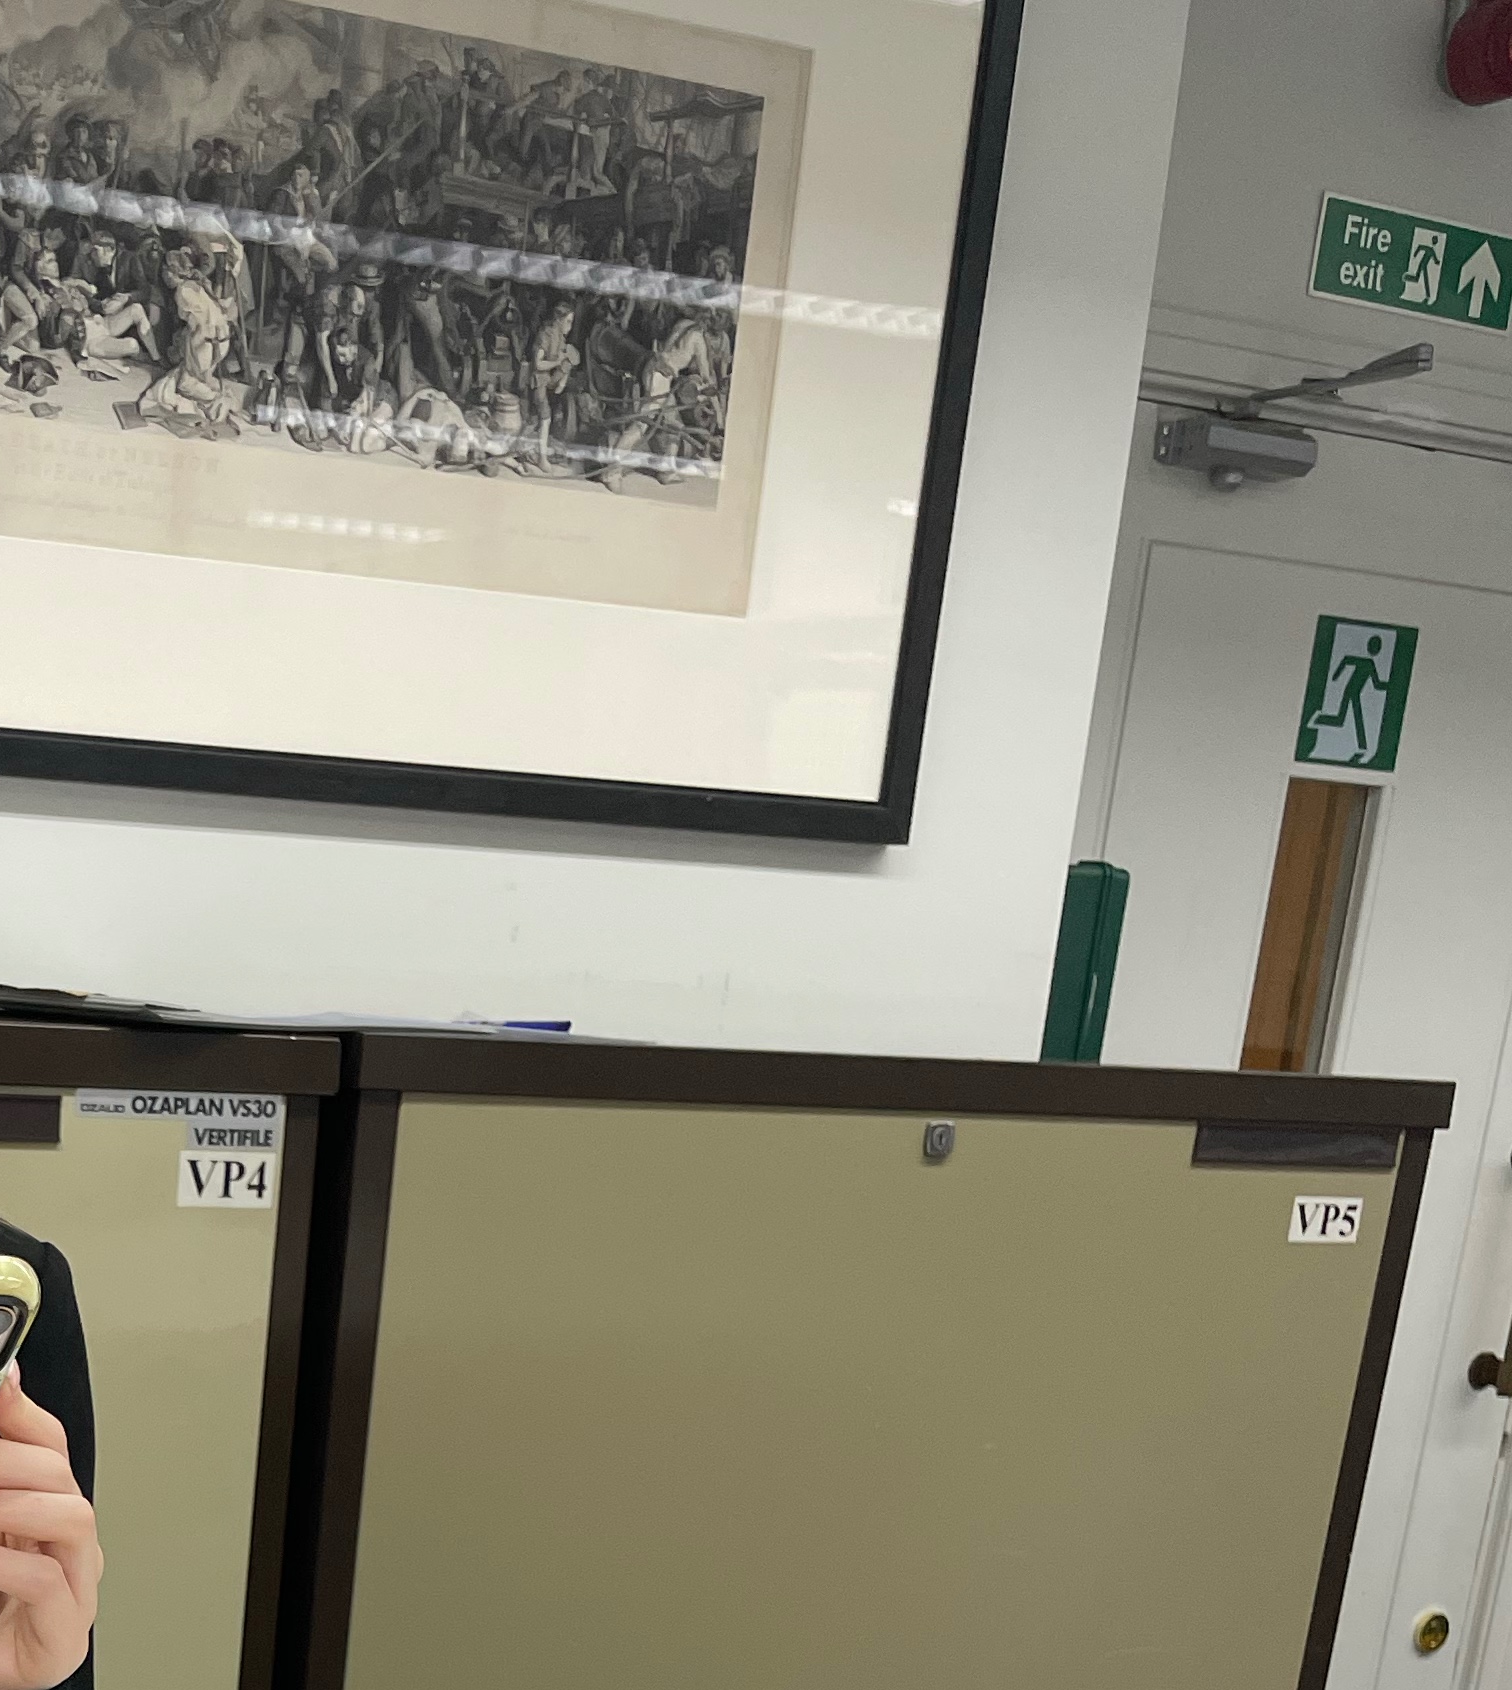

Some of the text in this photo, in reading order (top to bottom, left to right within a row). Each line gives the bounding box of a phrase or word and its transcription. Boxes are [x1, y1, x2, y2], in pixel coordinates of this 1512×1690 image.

[1343, 214, 1392, 252] Fire
[1339, 259, 1384, 292] exit
[131, 1095, 224, 1116] OZAPLAN
[228, 1100, 276, 1118] VS30
[194, 1127, 273, 1147] VERTIFILE
[188, 1160, 267, 1199] VP4
[1298, 1203, 1358, 1237] VP5
